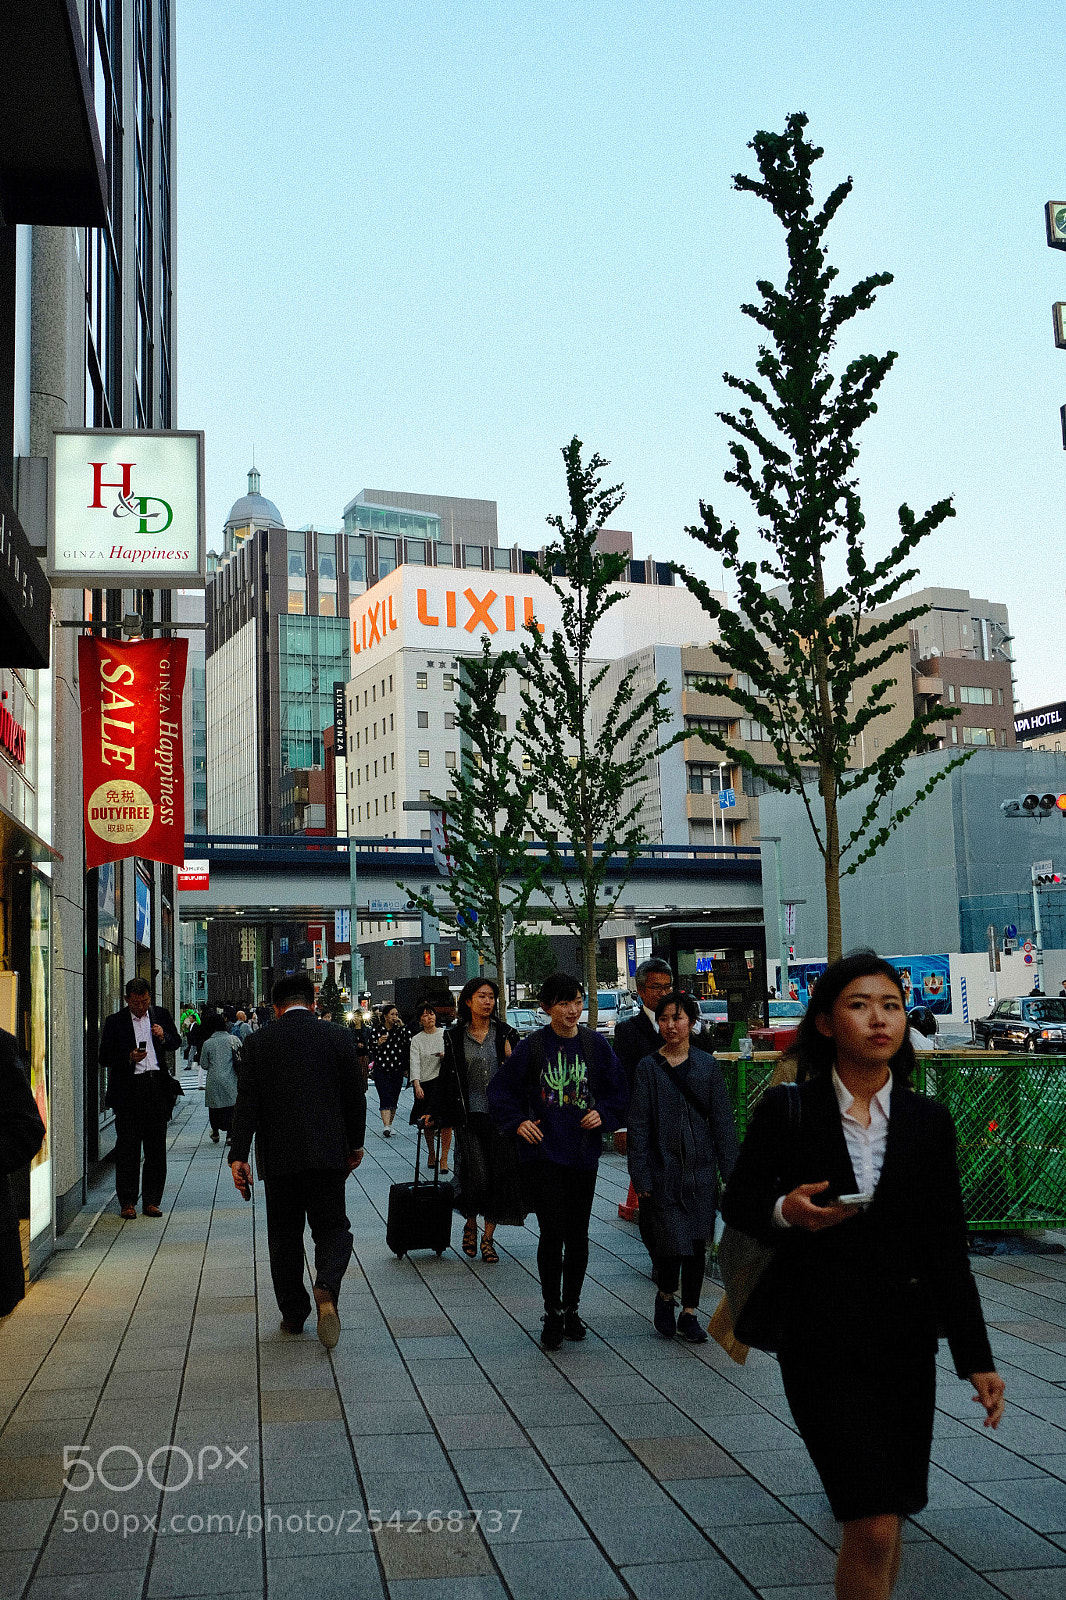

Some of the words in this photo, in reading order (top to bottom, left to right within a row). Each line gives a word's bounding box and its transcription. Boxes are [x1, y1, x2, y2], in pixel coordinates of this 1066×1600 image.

[63, 550, 105, 559] GINZA
[108, 544, 190, 563] Happiness
[352, 594, 398, 654] LIXIL
[416, 587, 545, 634] LIXIL
[158, 659, 170, 714] GINZA
[100, 659, 135, 770] SALE
[1031, 710, 1063, 729] HOTEL
[155, 718, 179, 826] Happiness
[106, 789, 135, 803] 免税
[91, 806, 150, 820] DUTYFREE
[107, 824, 134, 833] 取扱店
